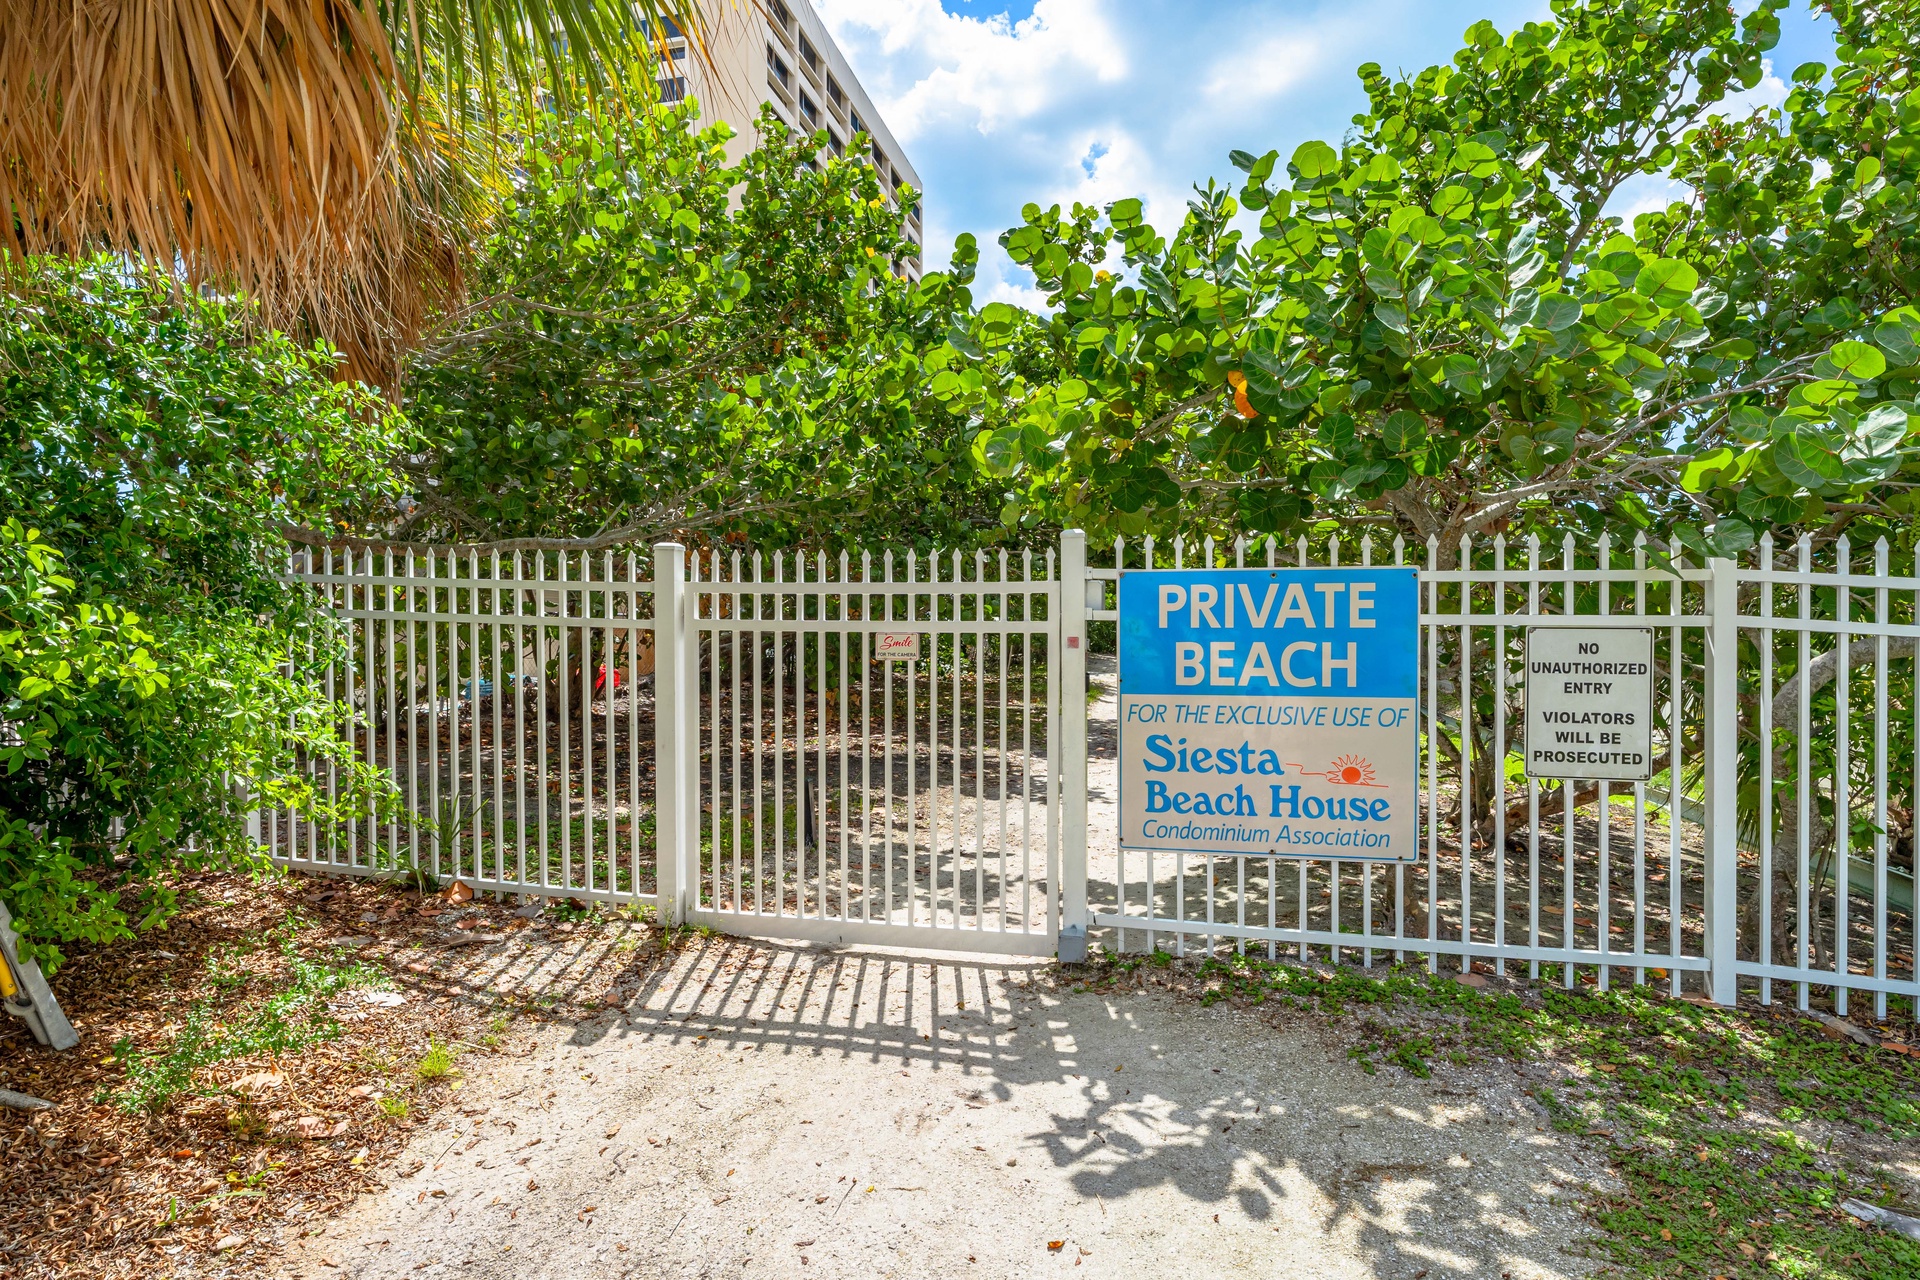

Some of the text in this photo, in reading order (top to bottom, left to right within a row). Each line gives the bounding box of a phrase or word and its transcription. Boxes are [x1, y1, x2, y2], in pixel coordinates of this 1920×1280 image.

[1158, 582, 1377, 629] PRIVATE
[880, 635, 914, 650] Smile
[1578, 642, 1600, 655] NO
[1175, 641, 1357, 688] BEACH
[1531, 661, 1648, 675] UNAUTHORIZED
[1564, 682, 1613, 695] ENTRY
[1127, 703, 1410, 728] FOR THE EXCLUSIVE USE OF
[1542, 711, 1635, 725] VIOLATORS
[1555, 731, 1621, 745] WILL BE
[1143, 733, 1285, 776] Siesta
[1533, 750, 1643, 765] PROSECUTED
[1144, 780, 1391, 822] Beach House
[1142, 819, 1390, 848] Condominium Association
